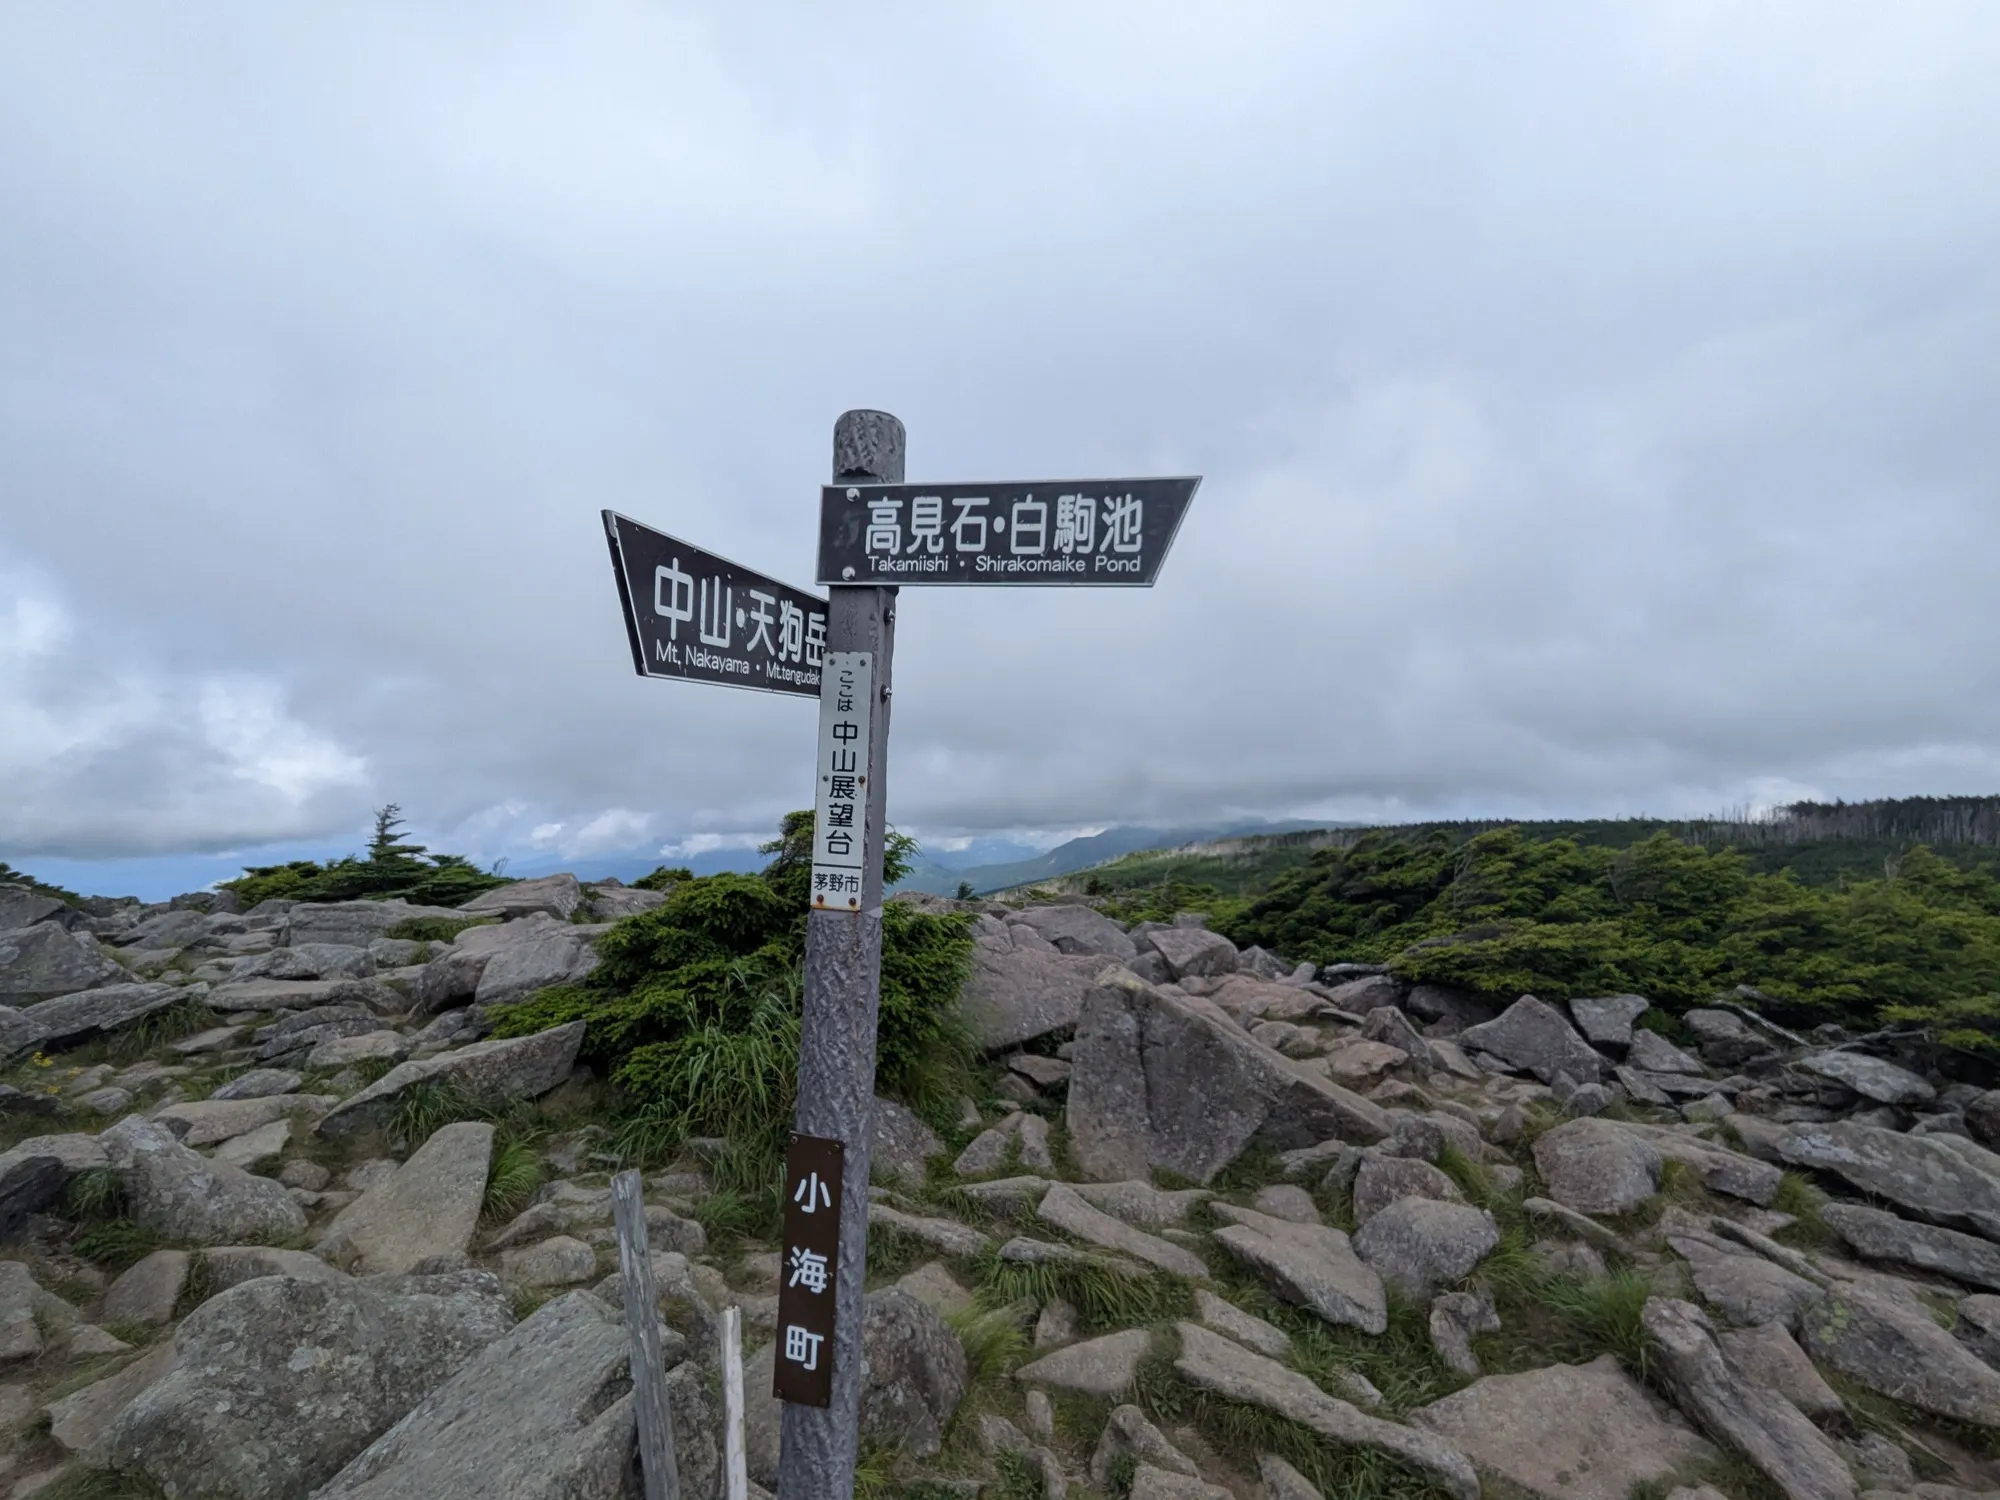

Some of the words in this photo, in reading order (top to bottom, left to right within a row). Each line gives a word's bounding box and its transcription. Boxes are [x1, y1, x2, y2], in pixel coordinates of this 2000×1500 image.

[865, 492, 1143, 555] 高見石・白駒池
[868, 554, 949, 572] Takamiishi
[975, 554, 1086, 572] Shirakomaike
[1095, 554, 1141, 572] Pond
[654, 557, 827, 667] 中山・天狗岳
[656, 638, 682, 665] Mt.
[685, 644, 750, 675] Nakayama
[837, 670, 855, 712] ここは
[825, 720, 859, 855] 中山展望台
[813, 872, 860, 894] 茅野市
[785, 1171, 832, 1371] 小海町
